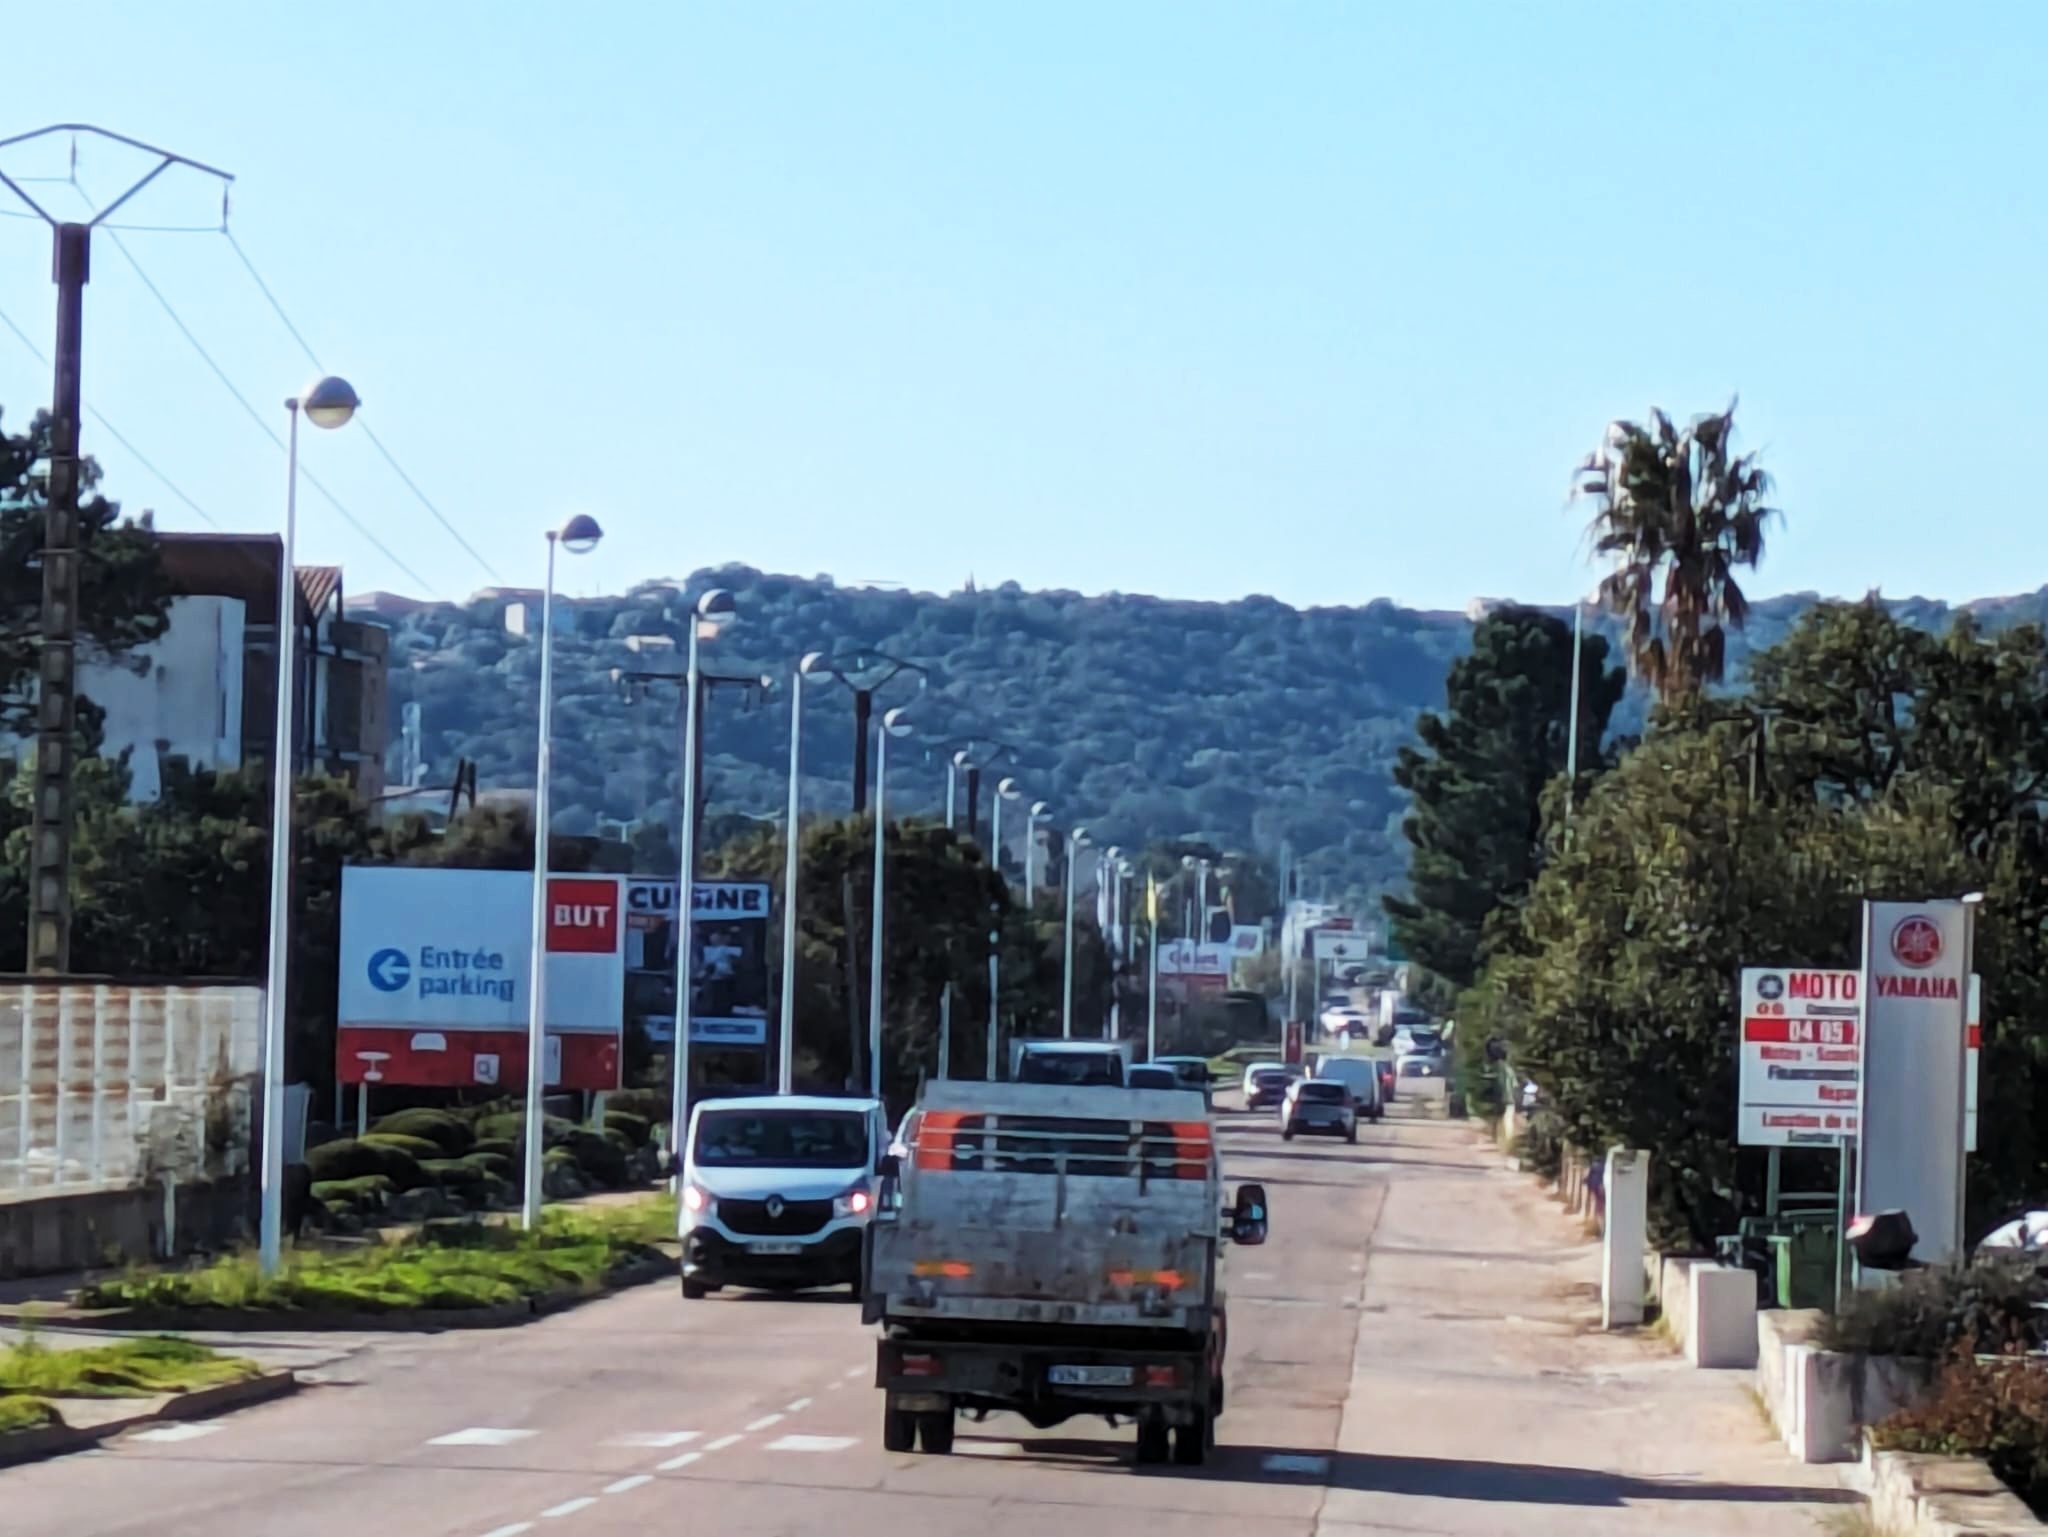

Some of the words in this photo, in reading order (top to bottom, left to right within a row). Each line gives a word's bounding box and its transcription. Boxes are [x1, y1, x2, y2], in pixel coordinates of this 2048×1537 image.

[554, 904, 611, 928] BUT
[420, 946, 503, 970] Entrée
[419, 974, 515, 1002] parking
[1789, 973, 1857, 1000] MOTO
[1875, 975, 1959, 999] YAMAHA
[1789, 1020, 1813, 1042] 04
